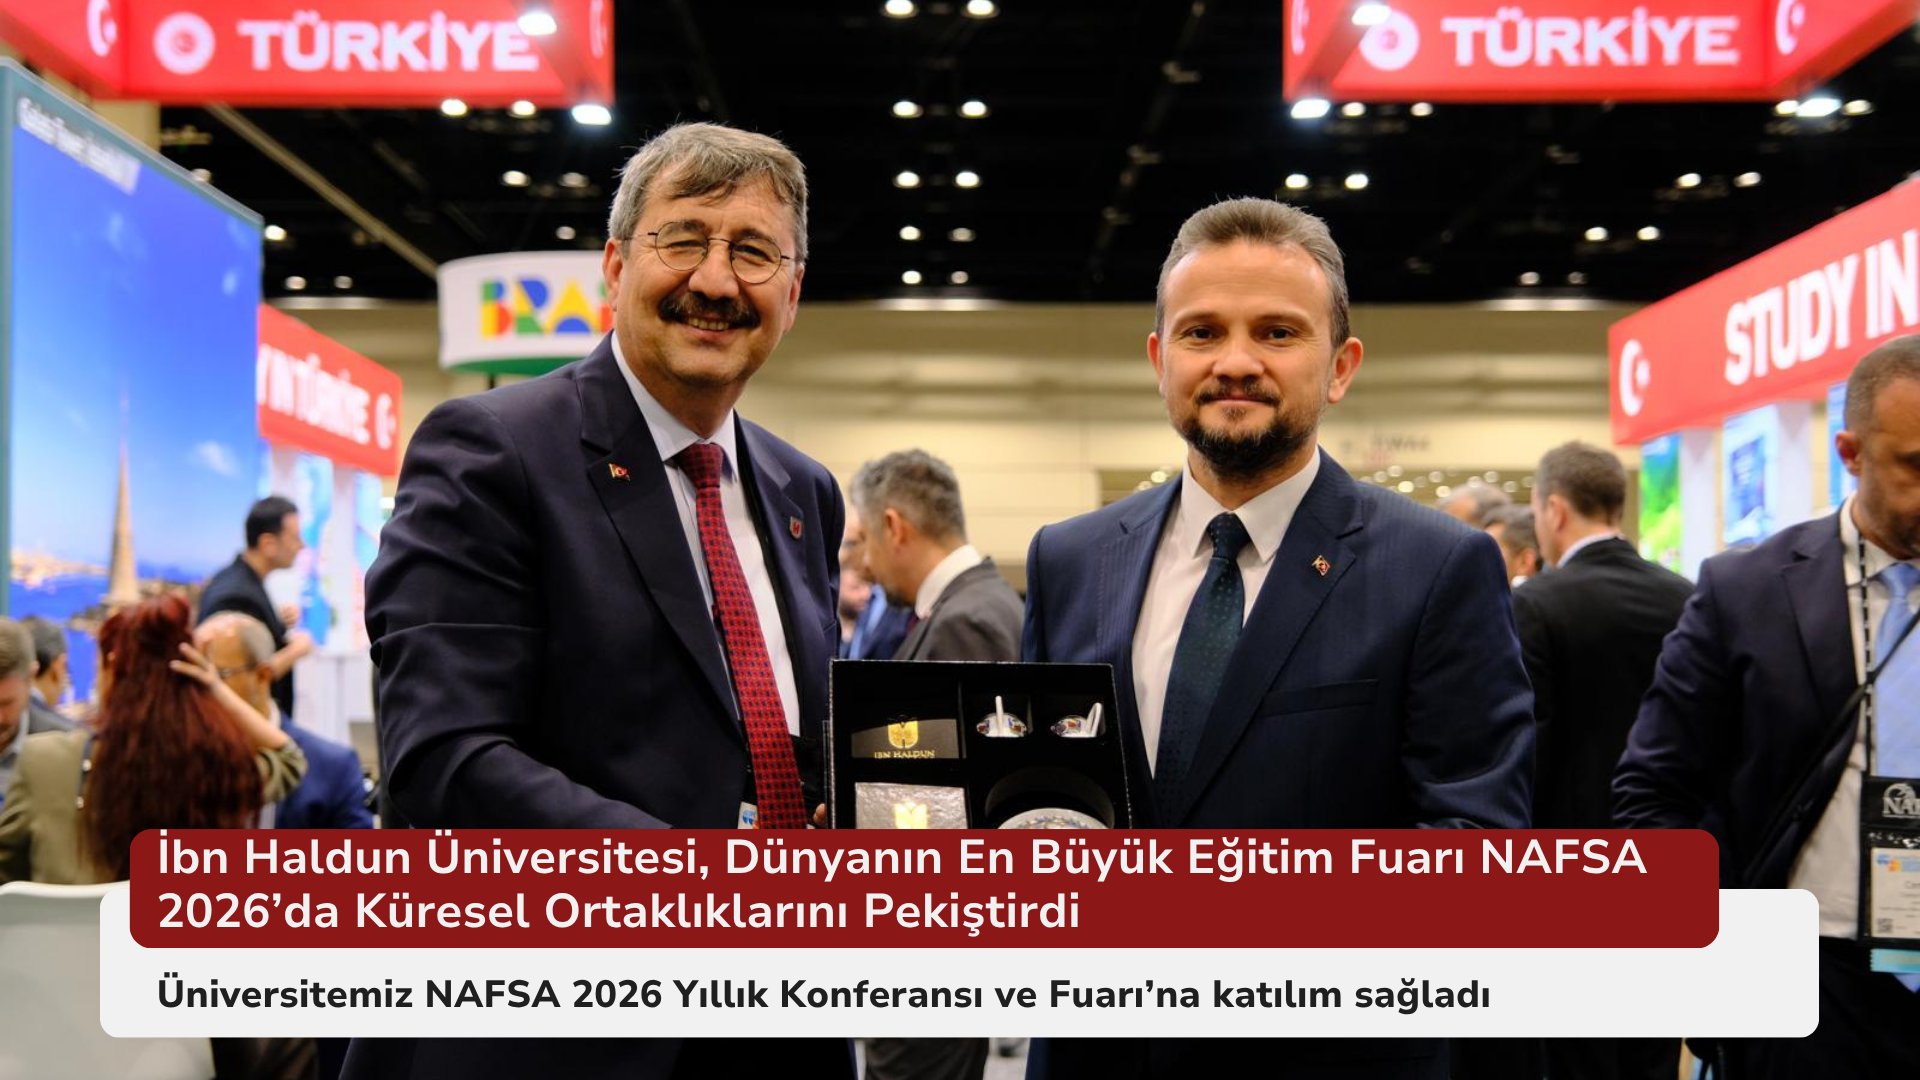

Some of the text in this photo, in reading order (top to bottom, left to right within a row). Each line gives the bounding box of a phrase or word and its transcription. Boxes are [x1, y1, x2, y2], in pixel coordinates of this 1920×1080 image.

[237, 10, 540, 72] TÜRKİYE
[1440, 6, 1740, 67] TÜRKİYE
[1724, 228, 1920, 386] STUDY IN
